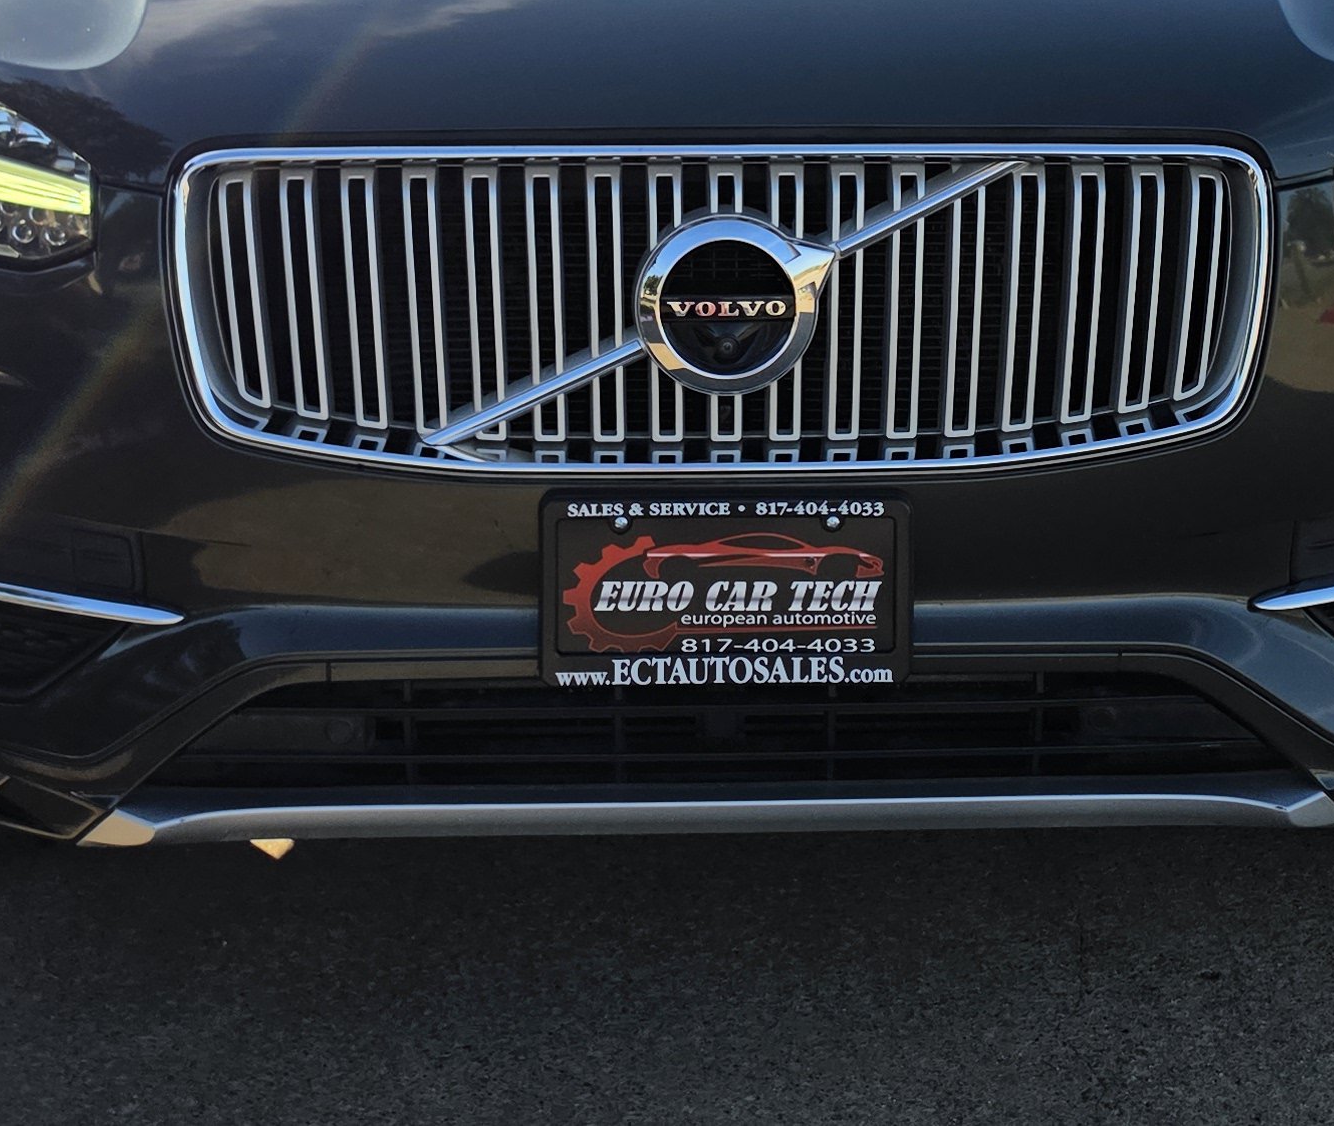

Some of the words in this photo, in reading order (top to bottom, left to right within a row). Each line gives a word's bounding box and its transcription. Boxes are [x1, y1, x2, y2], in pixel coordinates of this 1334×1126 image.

[667, 300, 786, 317] VOLVO
[567, 502, 624, 517] SALES
[628, 503, 644, 516] &
[649, 502, 731, 516] SERVICE
[755, 500, 885, 516] 817-404-4033
[594, 581, 695, 612] EURO
[705, 581, 778, 612] CAR
[788, 581, 883, 612] TECH
[680, 613, 767, 627] european
[772, 612, 877, 625] automotive
[681, 639, 876, 653] 817-404-4033
[555, 657, 893, 686] www.ECTAUTOSALES.com
